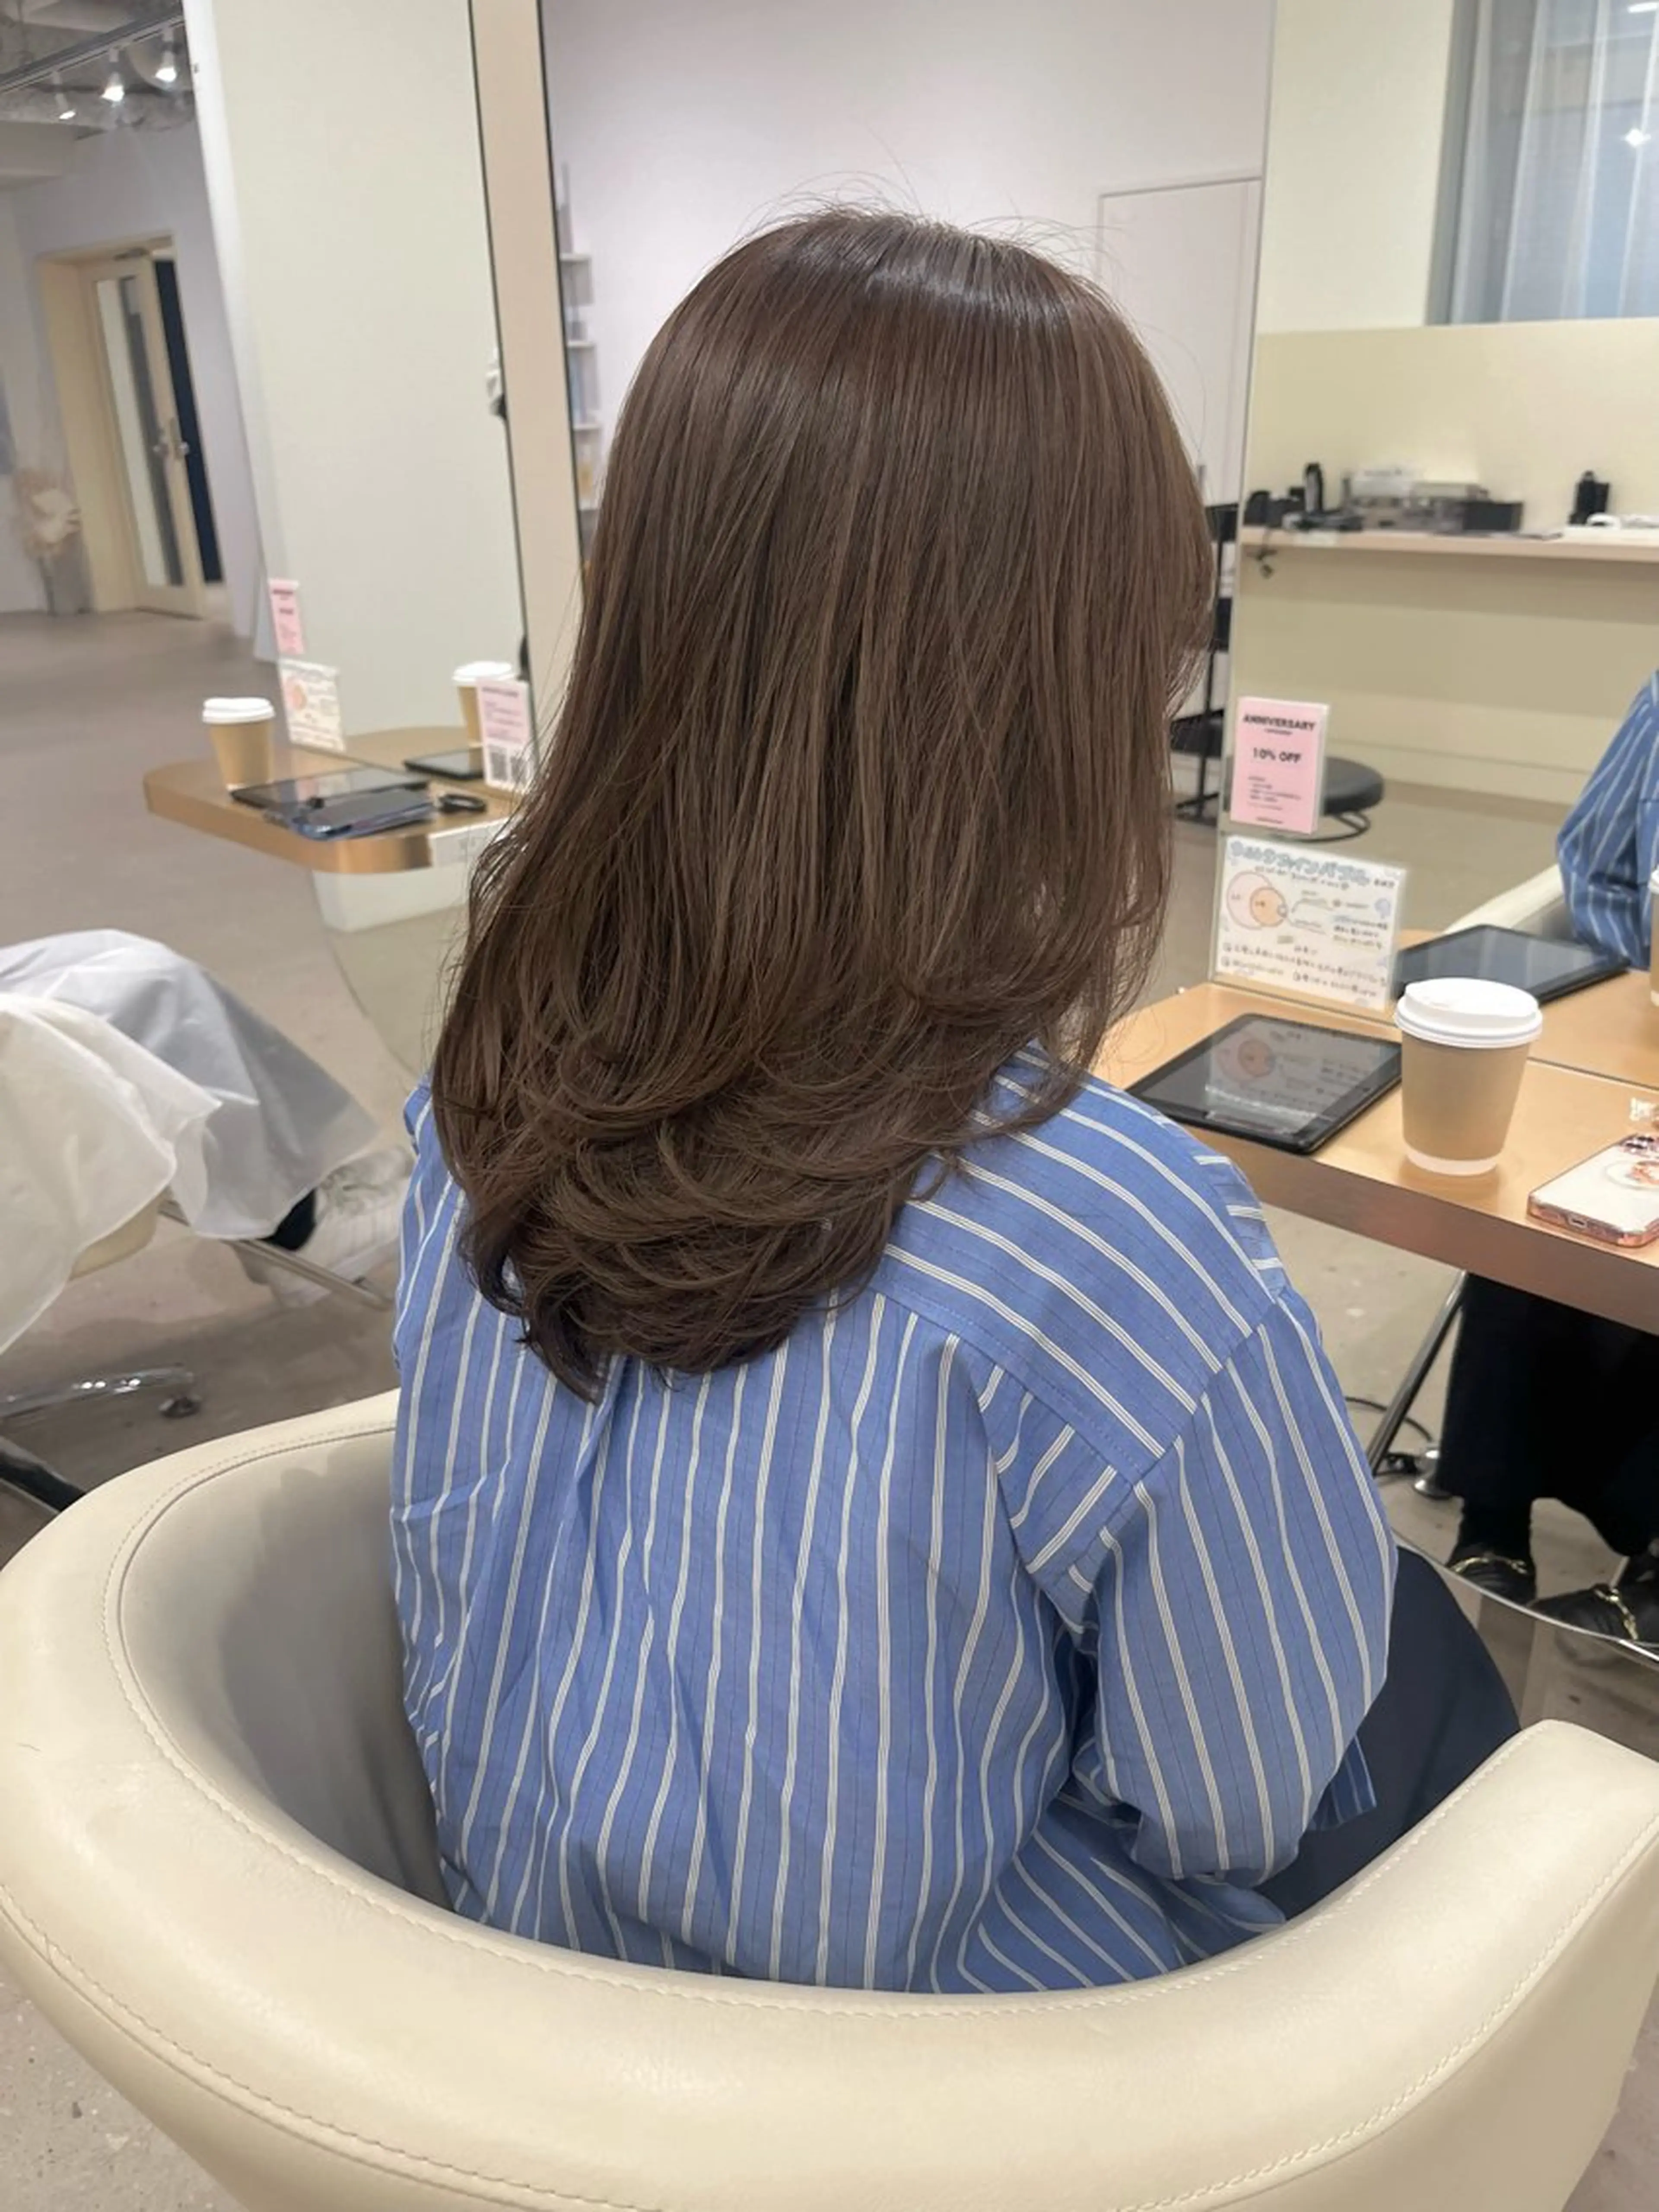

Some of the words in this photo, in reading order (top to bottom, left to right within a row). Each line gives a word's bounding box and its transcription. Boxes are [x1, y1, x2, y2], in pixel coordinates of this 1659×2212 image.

[1243, 714, 1316, 731] ANNIVERSARY
[1253, 747, 1276, 760] 10%
[1279, 751, 1302, 763] OFF
